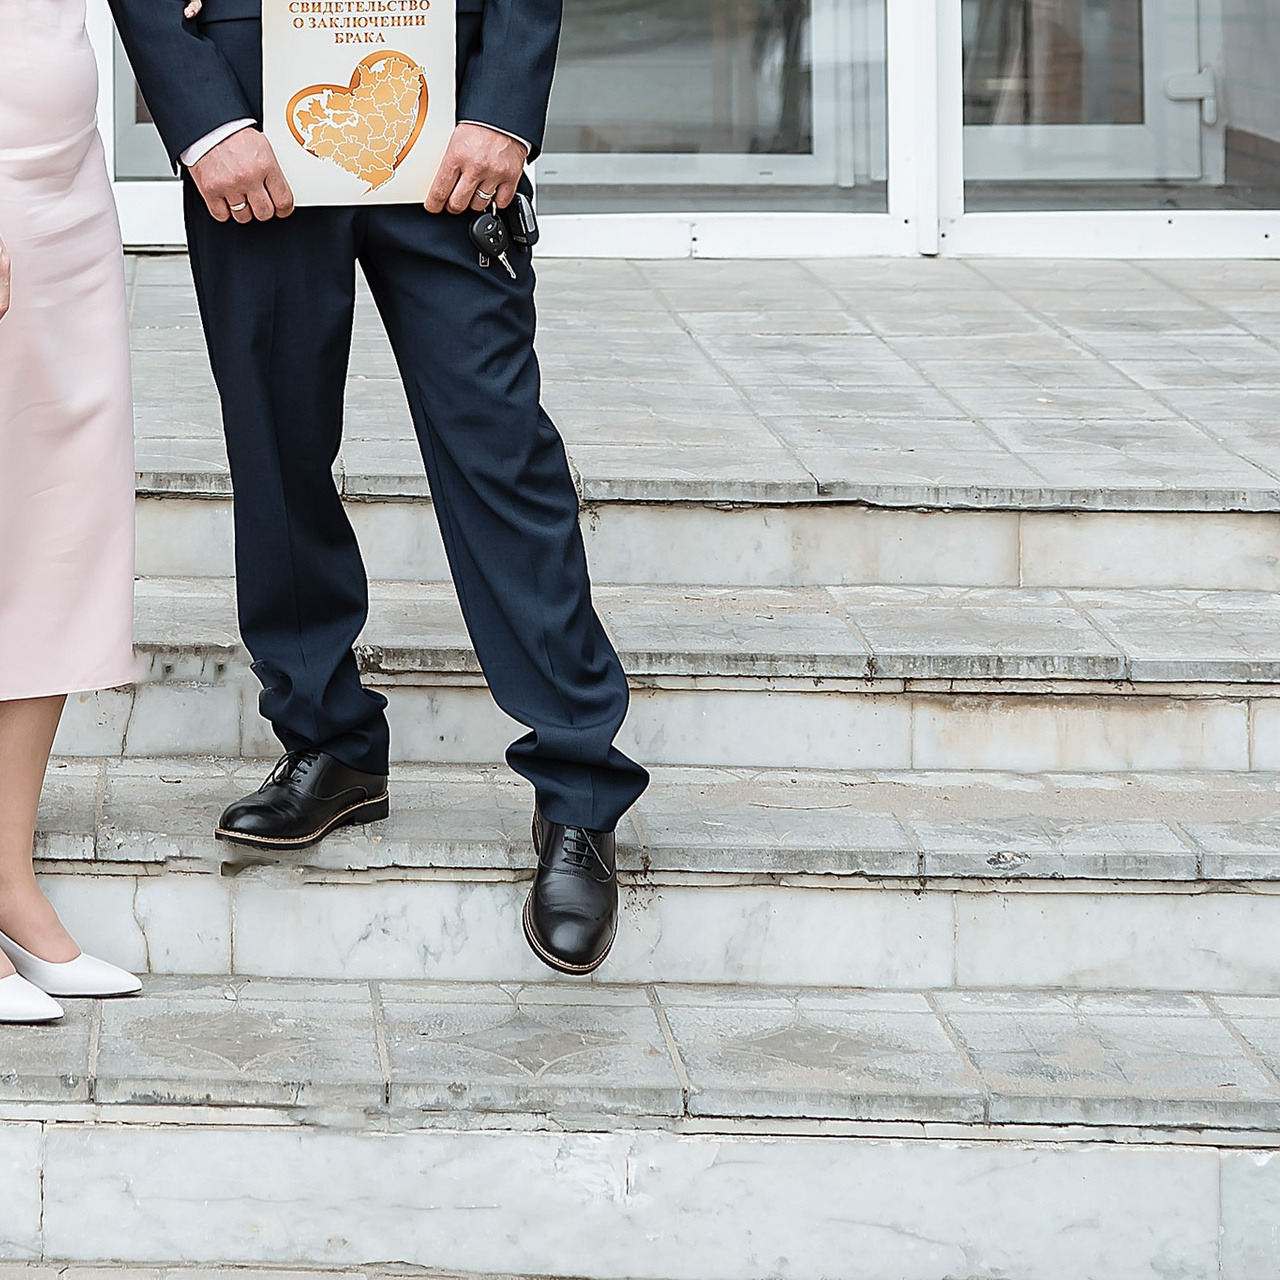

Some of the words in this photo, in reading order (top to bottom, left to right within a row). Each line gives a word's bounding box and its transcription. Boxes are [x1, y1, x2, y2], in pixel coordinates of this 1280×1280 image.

[288, 0, 431, 14] СВИДЕТЕЛЬСТВО
[293, 17, 304, 29] О
[309, 15, 427, 28] ЗАКЛЮЧЕНИИ
[334, 32, 386, 44] БРАКА
